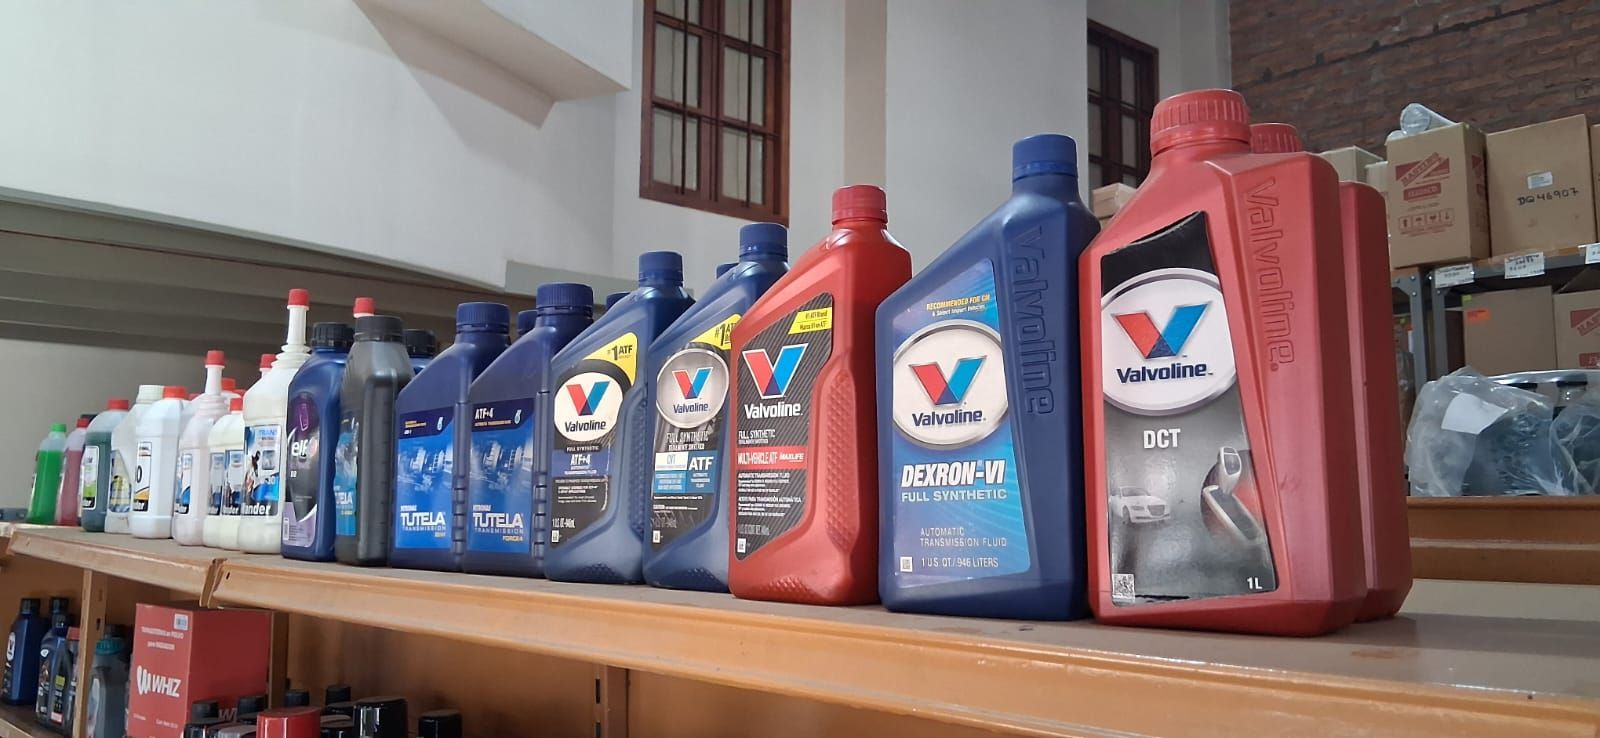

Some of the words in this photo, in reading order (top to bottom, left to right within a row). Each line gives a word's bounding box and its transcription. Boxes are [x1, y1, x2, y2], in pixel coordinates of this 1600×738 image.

[619, 345, 633, 354] ATF
[1117, 363, 1207, 384] Valvoline
[673, 403, 709, 414] Valvoline
[744, 402, 801, 419] Valvoline
[912, 409, 983, 426] Valvoline
[565, 420, 607, 432] Valvoline
[1144, 429, 1181, 449] DCT
[292, 439, 308, 457] elf
[689, 456, 714, 470] ATF
[902, 492, 930, 502] FULL
[933, 489, 1007, 502] SYNTHETIC
[400, 512, 446, 526] TUTELA
[473, 513, 523, 528] TUTELA
[920, 527, 965, 537] AUTOMATIC
[920, 538, 979, 547] TRANSMISSION
[982, 538, 1007, 547] FLUID
[1247, 577, 1263, 590] 1L
[153, 674, 181, 697] WHIZ
